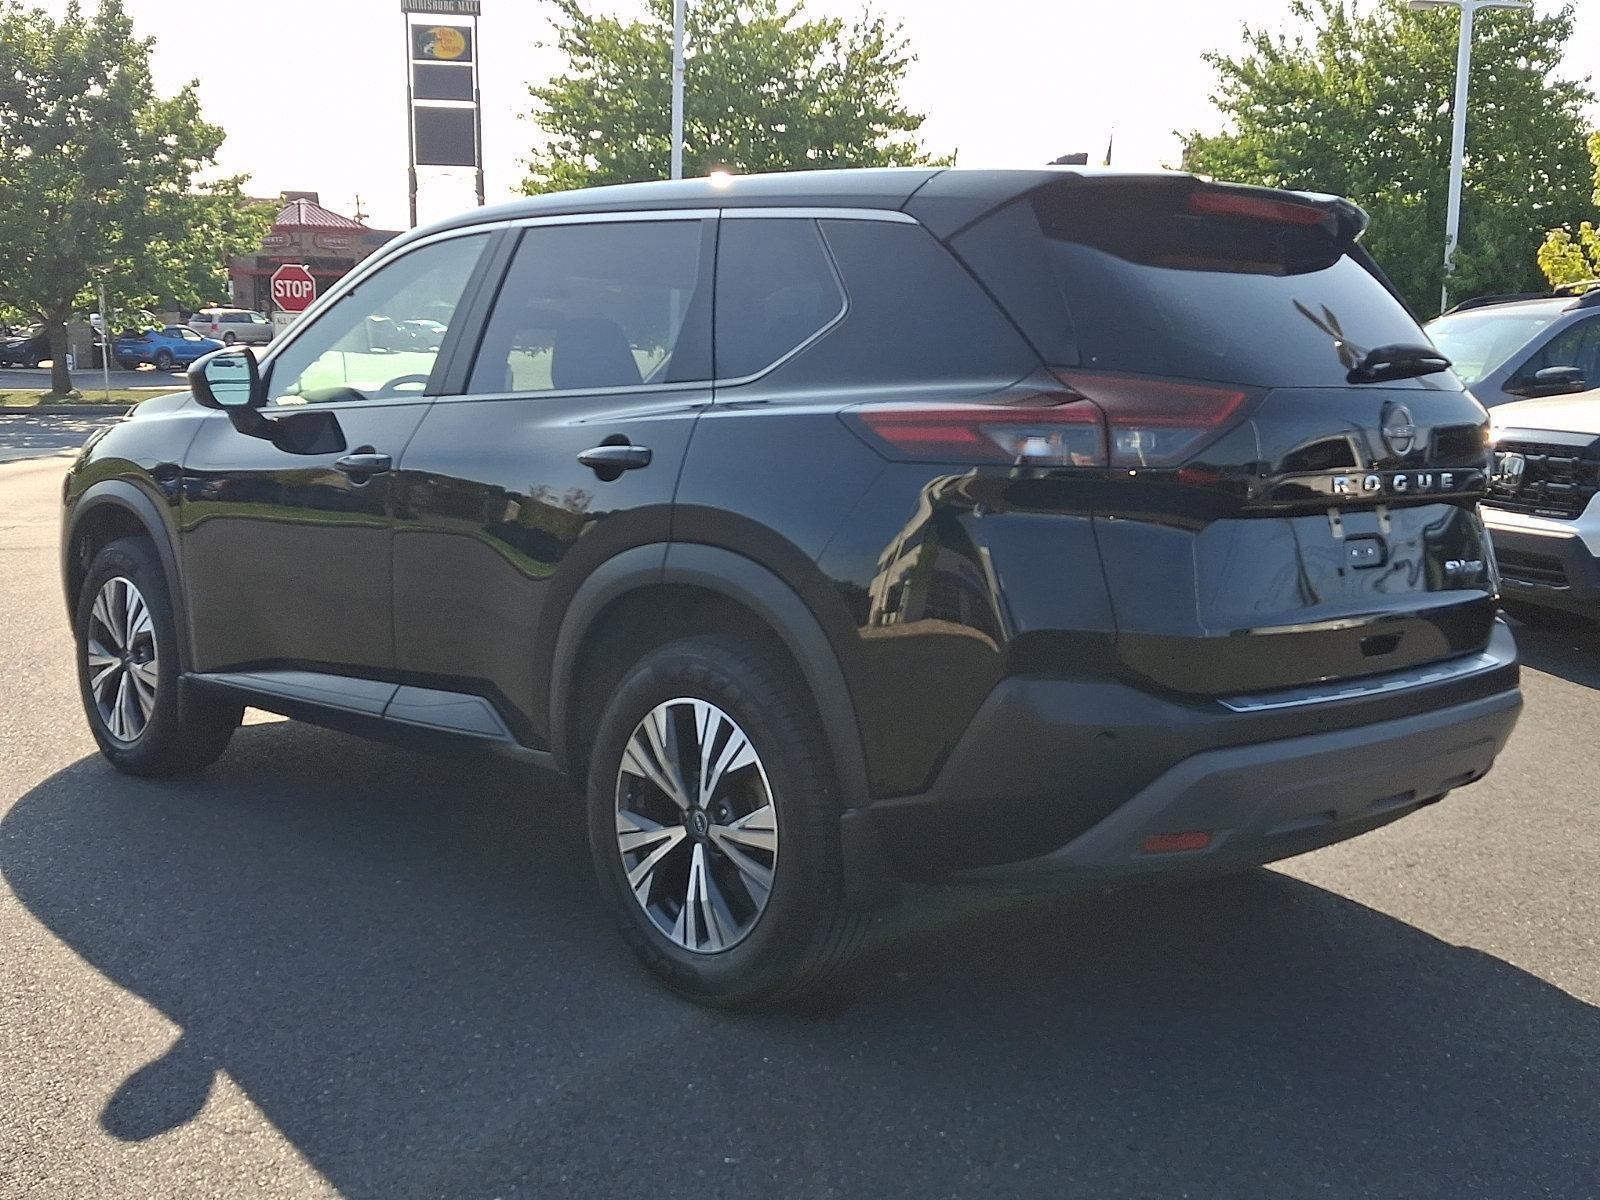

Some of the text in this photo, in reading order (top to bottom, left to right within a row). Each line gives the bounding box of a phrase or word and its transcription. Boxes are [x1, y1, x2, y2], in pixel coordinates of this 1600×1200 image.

[457, 1, 479, 12] MALL
[274, 280, 313, 298] STOP
[1332, 472, 1454, 494] ROGUE
